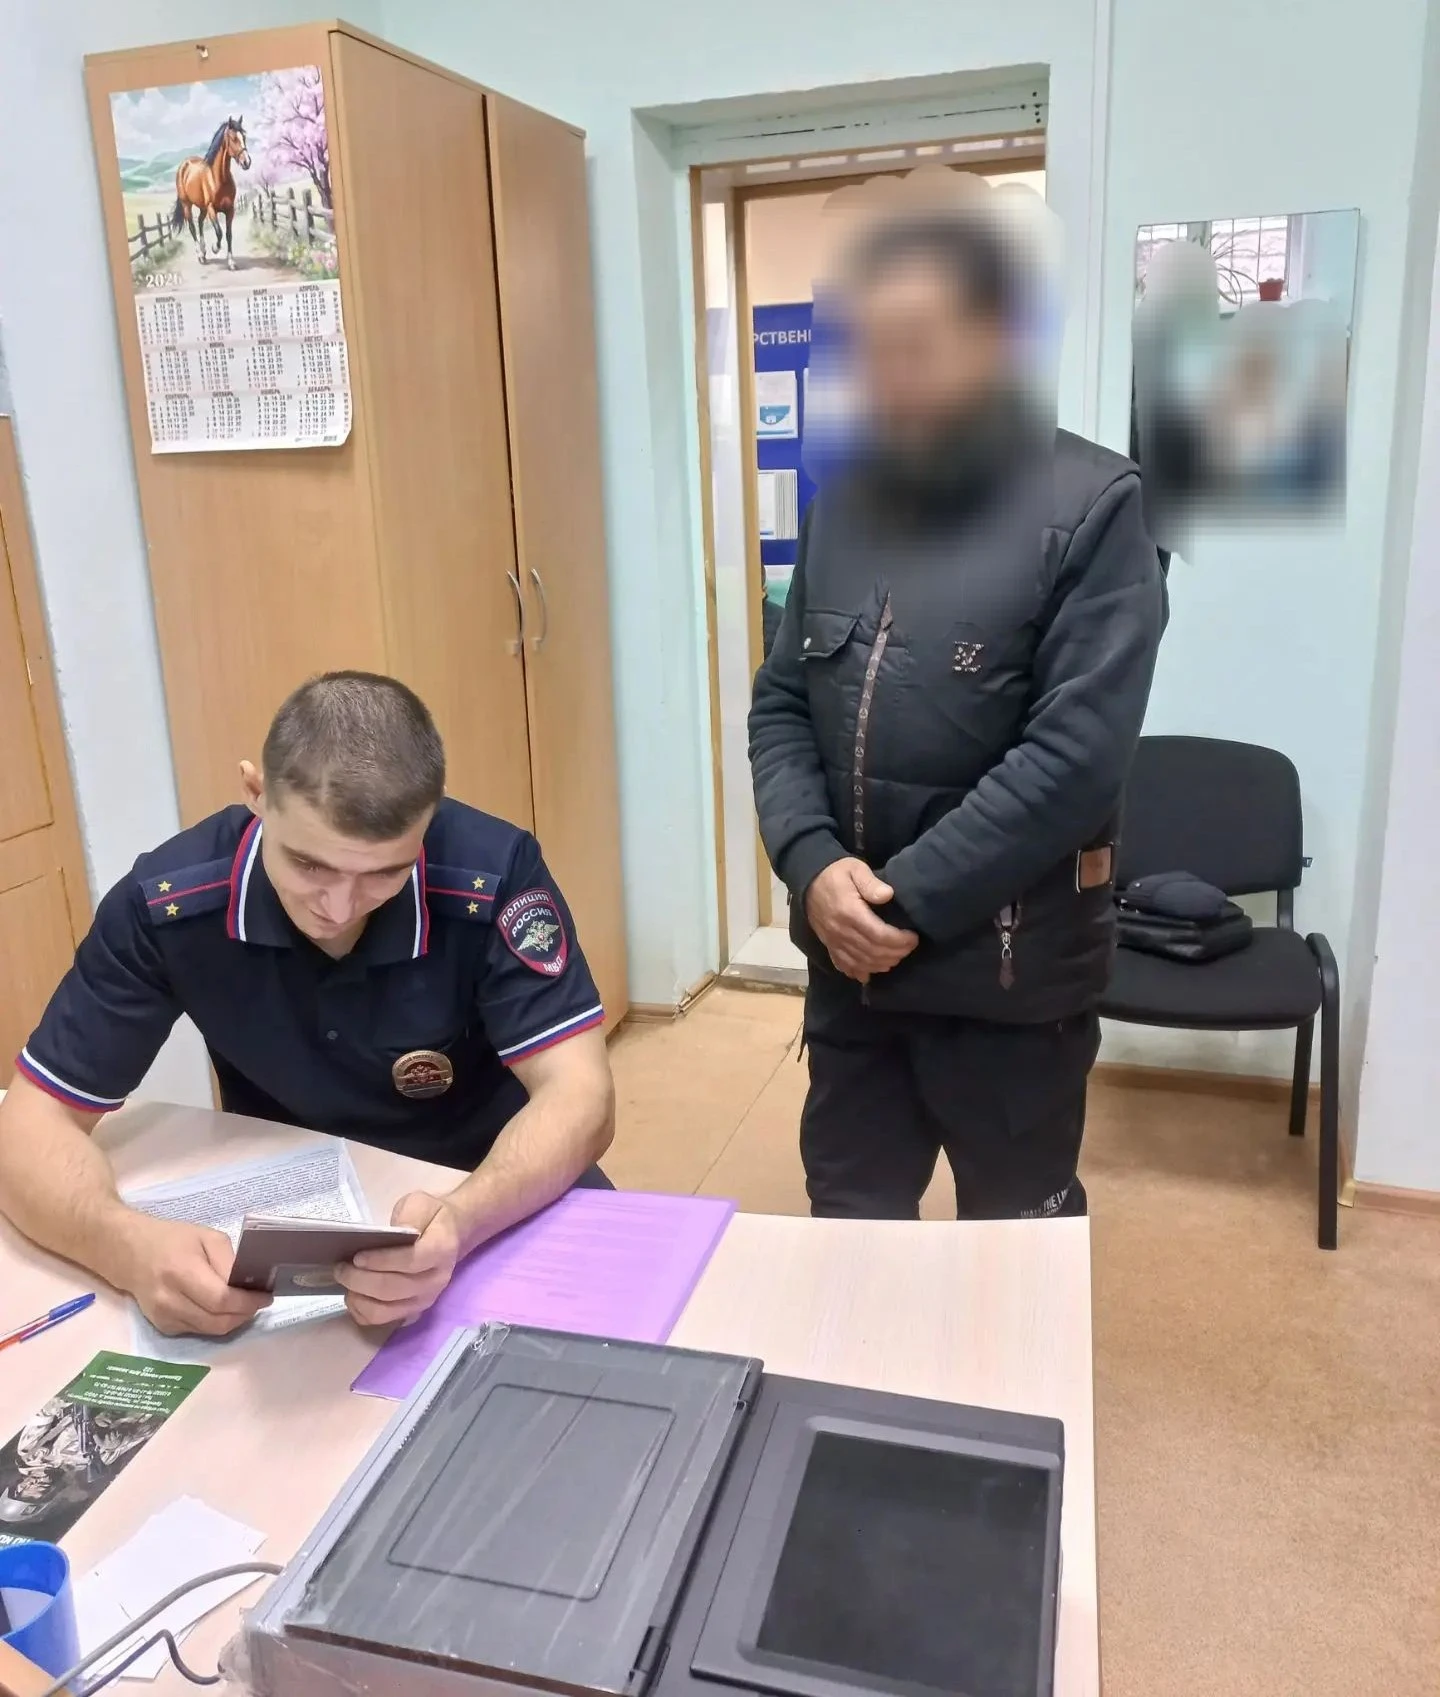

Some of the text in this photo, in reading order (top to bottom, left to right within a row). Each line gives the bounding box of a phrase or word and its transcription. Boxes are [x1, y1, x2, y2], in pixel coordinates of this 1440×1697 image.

[145, 273, 182, 288] 2026
[502, 893, 549, 927] ПОЛИЦИЯ
[512, 907, 552, 937] РОССИЯ
[543, 955, 563, 973] МВД
